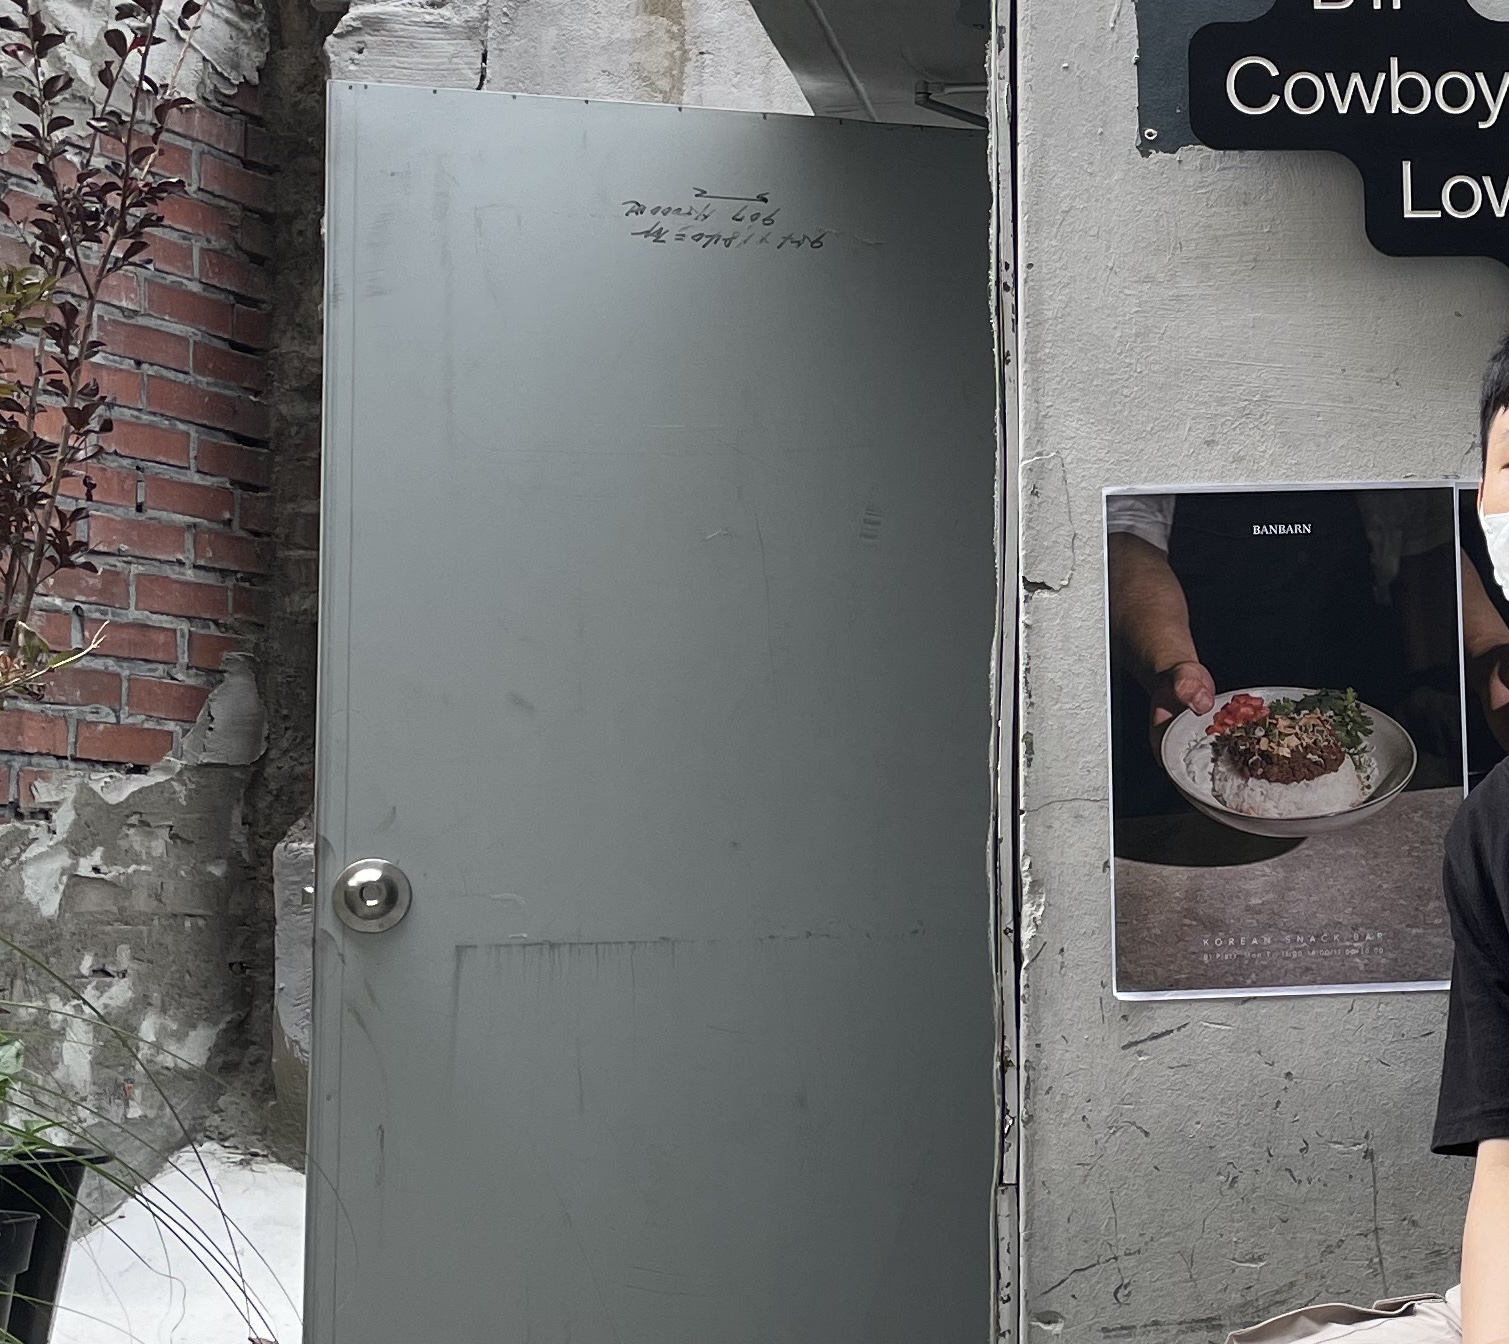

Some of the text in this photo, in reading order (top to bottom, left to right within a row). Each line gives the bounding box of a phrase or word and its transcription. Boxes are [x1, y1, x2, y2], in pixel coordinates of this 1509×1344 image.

[1252, 523, 1312, 535] BANBARN
[1202, 932, 1383, 947] KOREAN SNACK BAR
